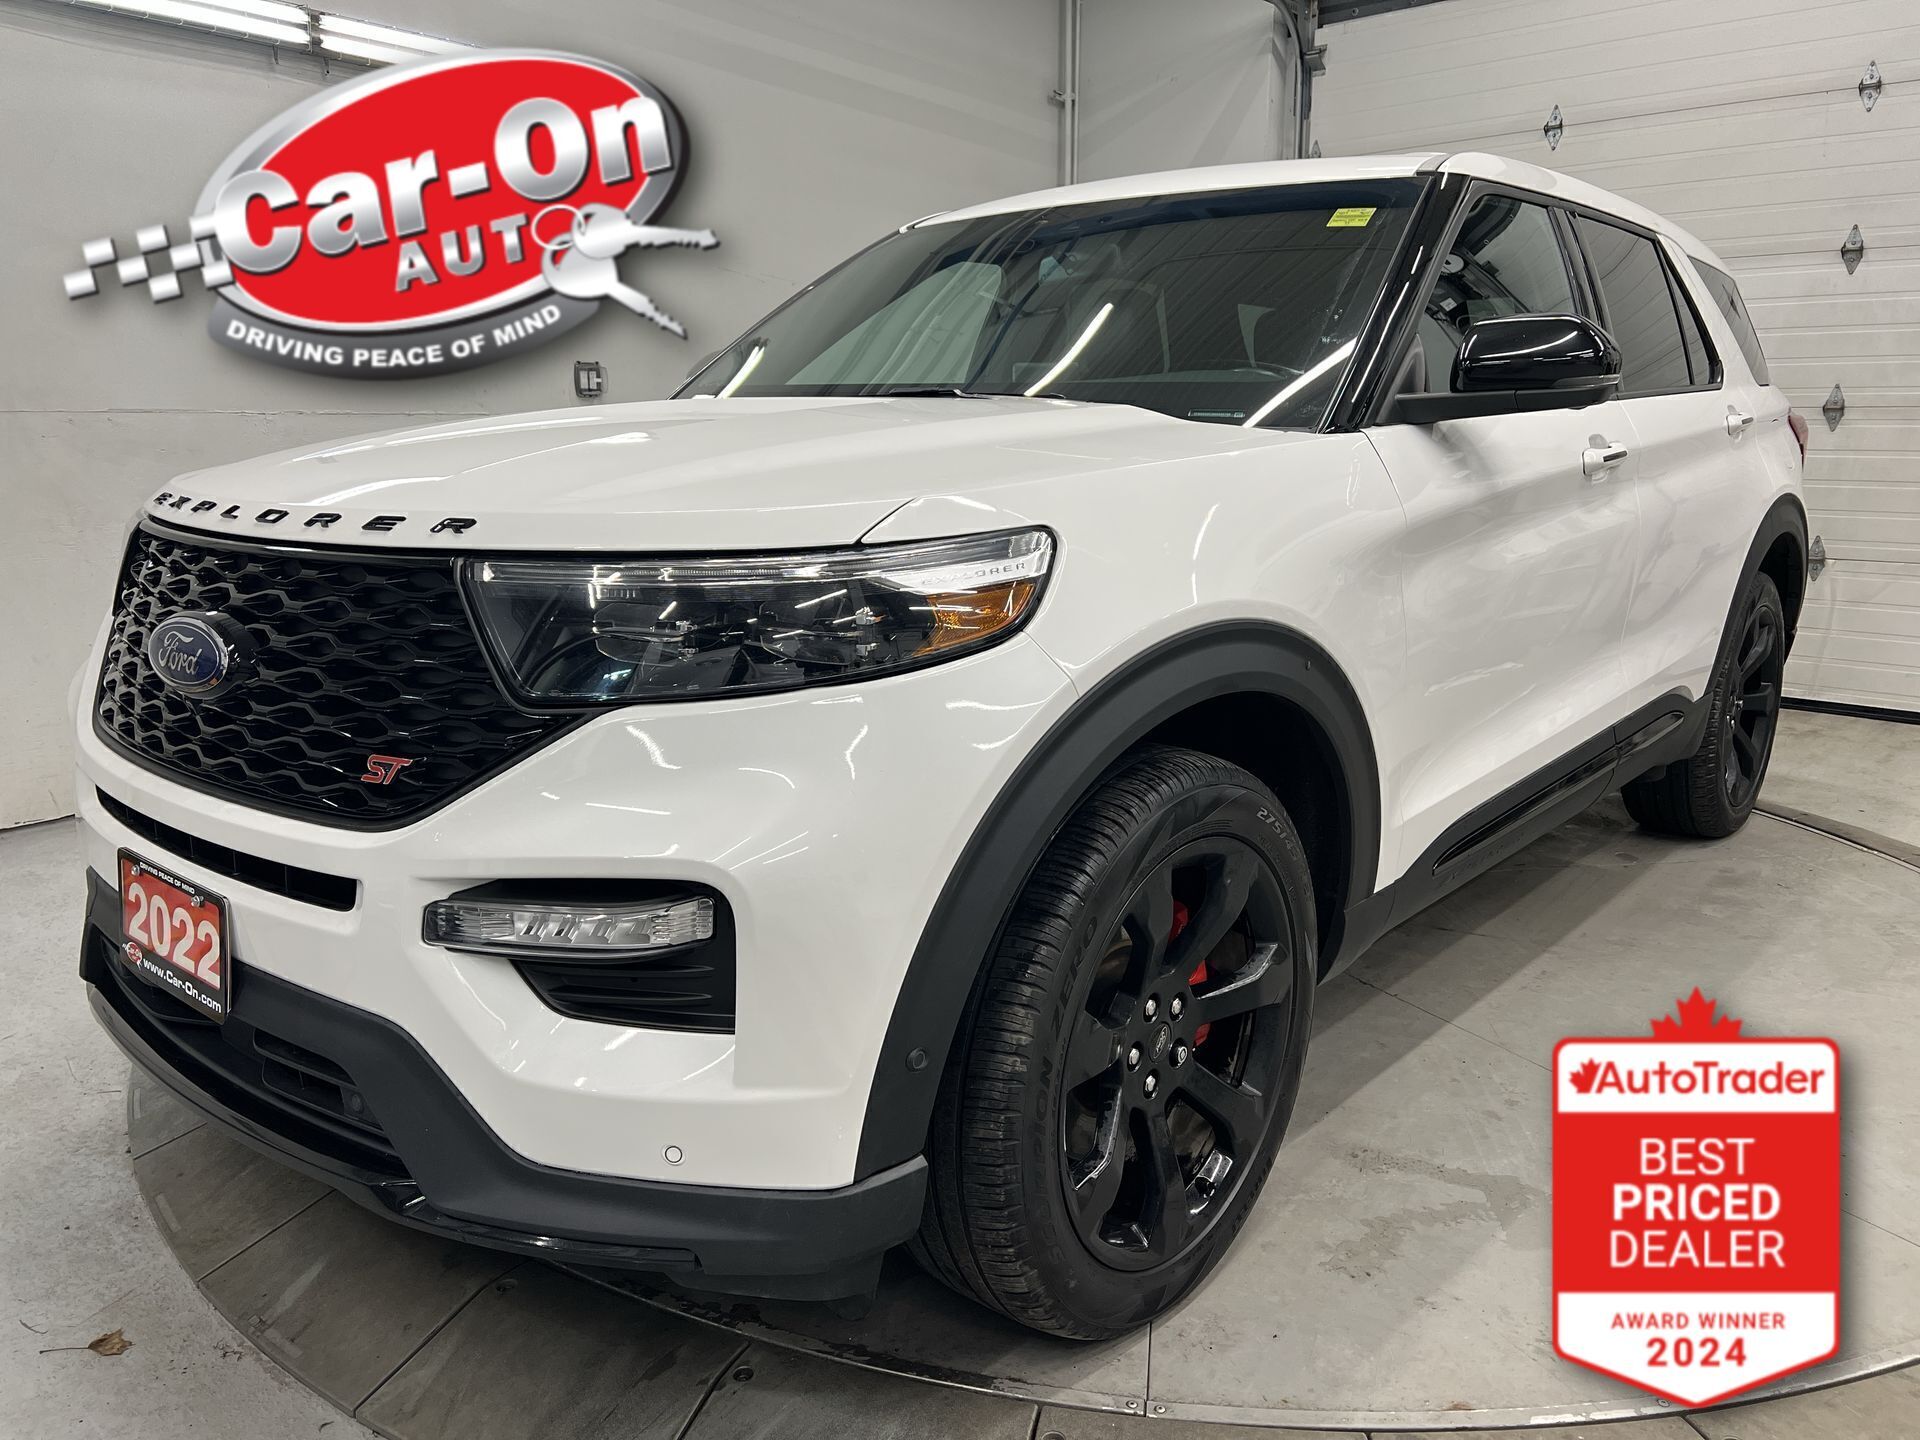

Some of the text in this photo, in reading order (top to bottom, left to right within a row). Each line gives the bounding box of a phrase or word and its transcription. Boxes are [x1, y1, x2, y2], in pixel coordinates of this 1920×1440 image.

[153, 491, 477, 536] EXPLORER
[158, 631, 203, 675] Ford
[360, 753, 413, 786] ST
[128, 882, 221, 989] 2022
[143, 958, 222, 1014] www.Car-On.com
